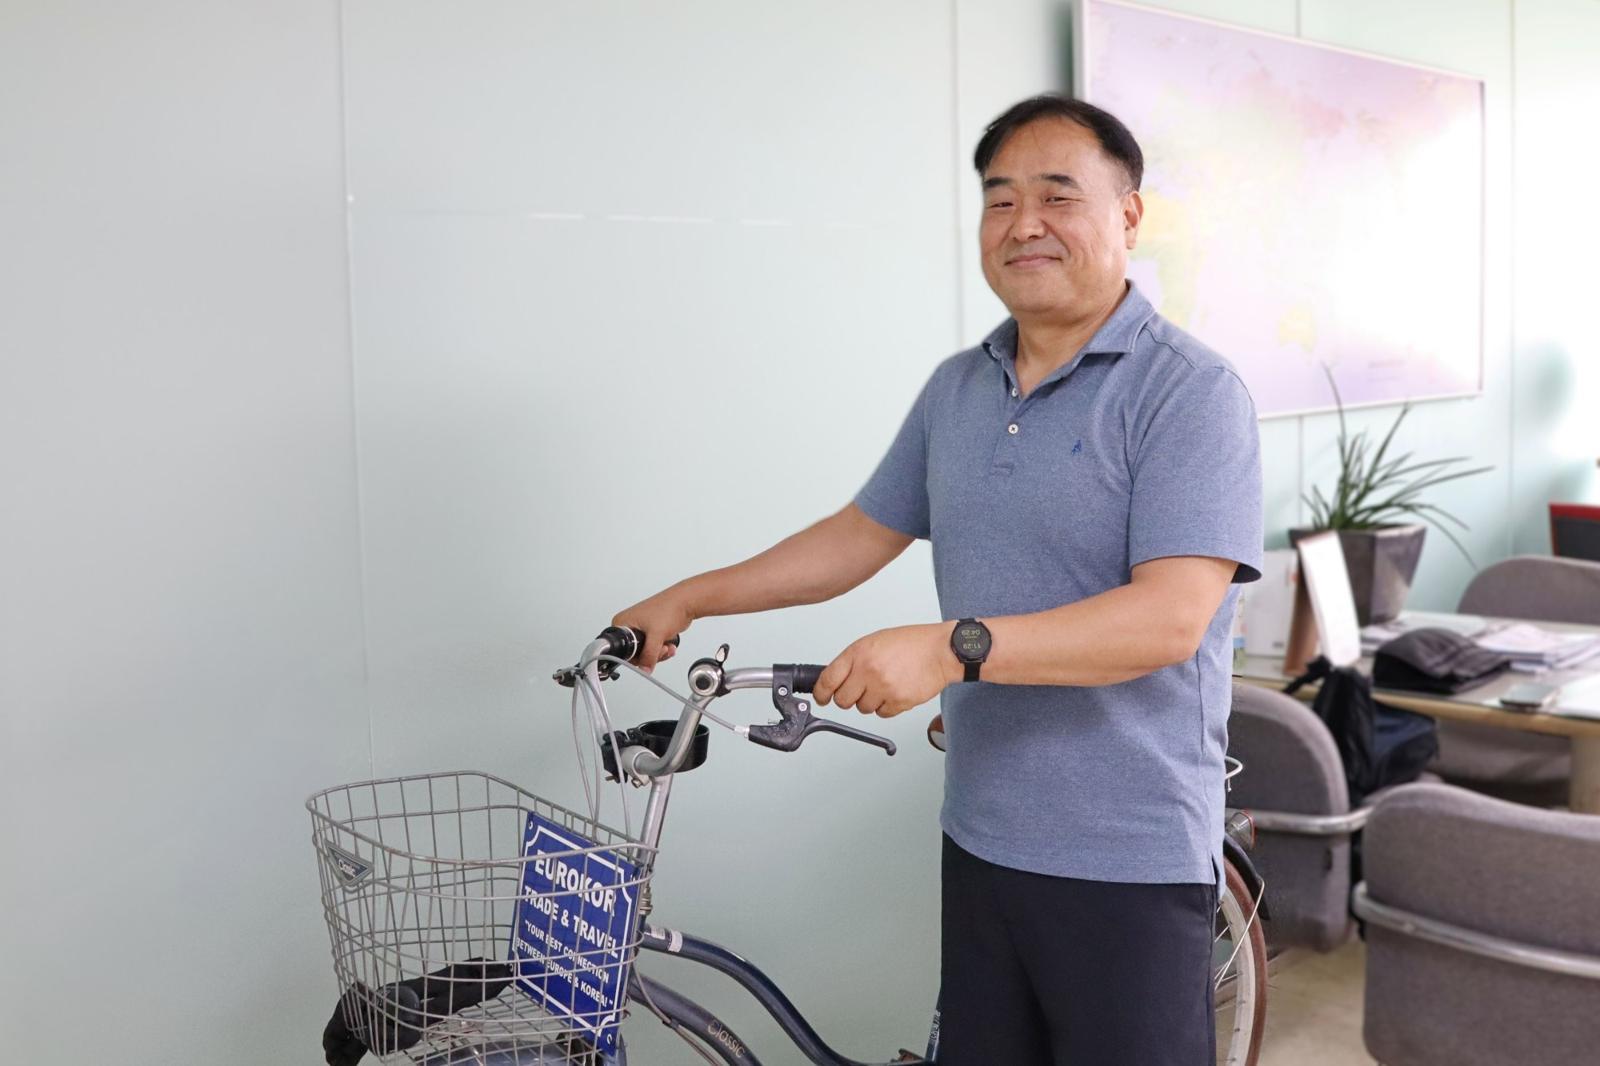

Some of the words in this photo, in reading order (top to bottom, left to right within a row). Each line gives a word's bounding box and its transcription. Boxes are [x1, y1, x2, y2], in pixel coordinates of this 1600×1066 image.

[535, 849, 616, 917] EUROKOR
[525, 885, 559, 920] TRADE
[561, 909, 569, 927] &
[574, 915, 618, 959] TRAVEL
